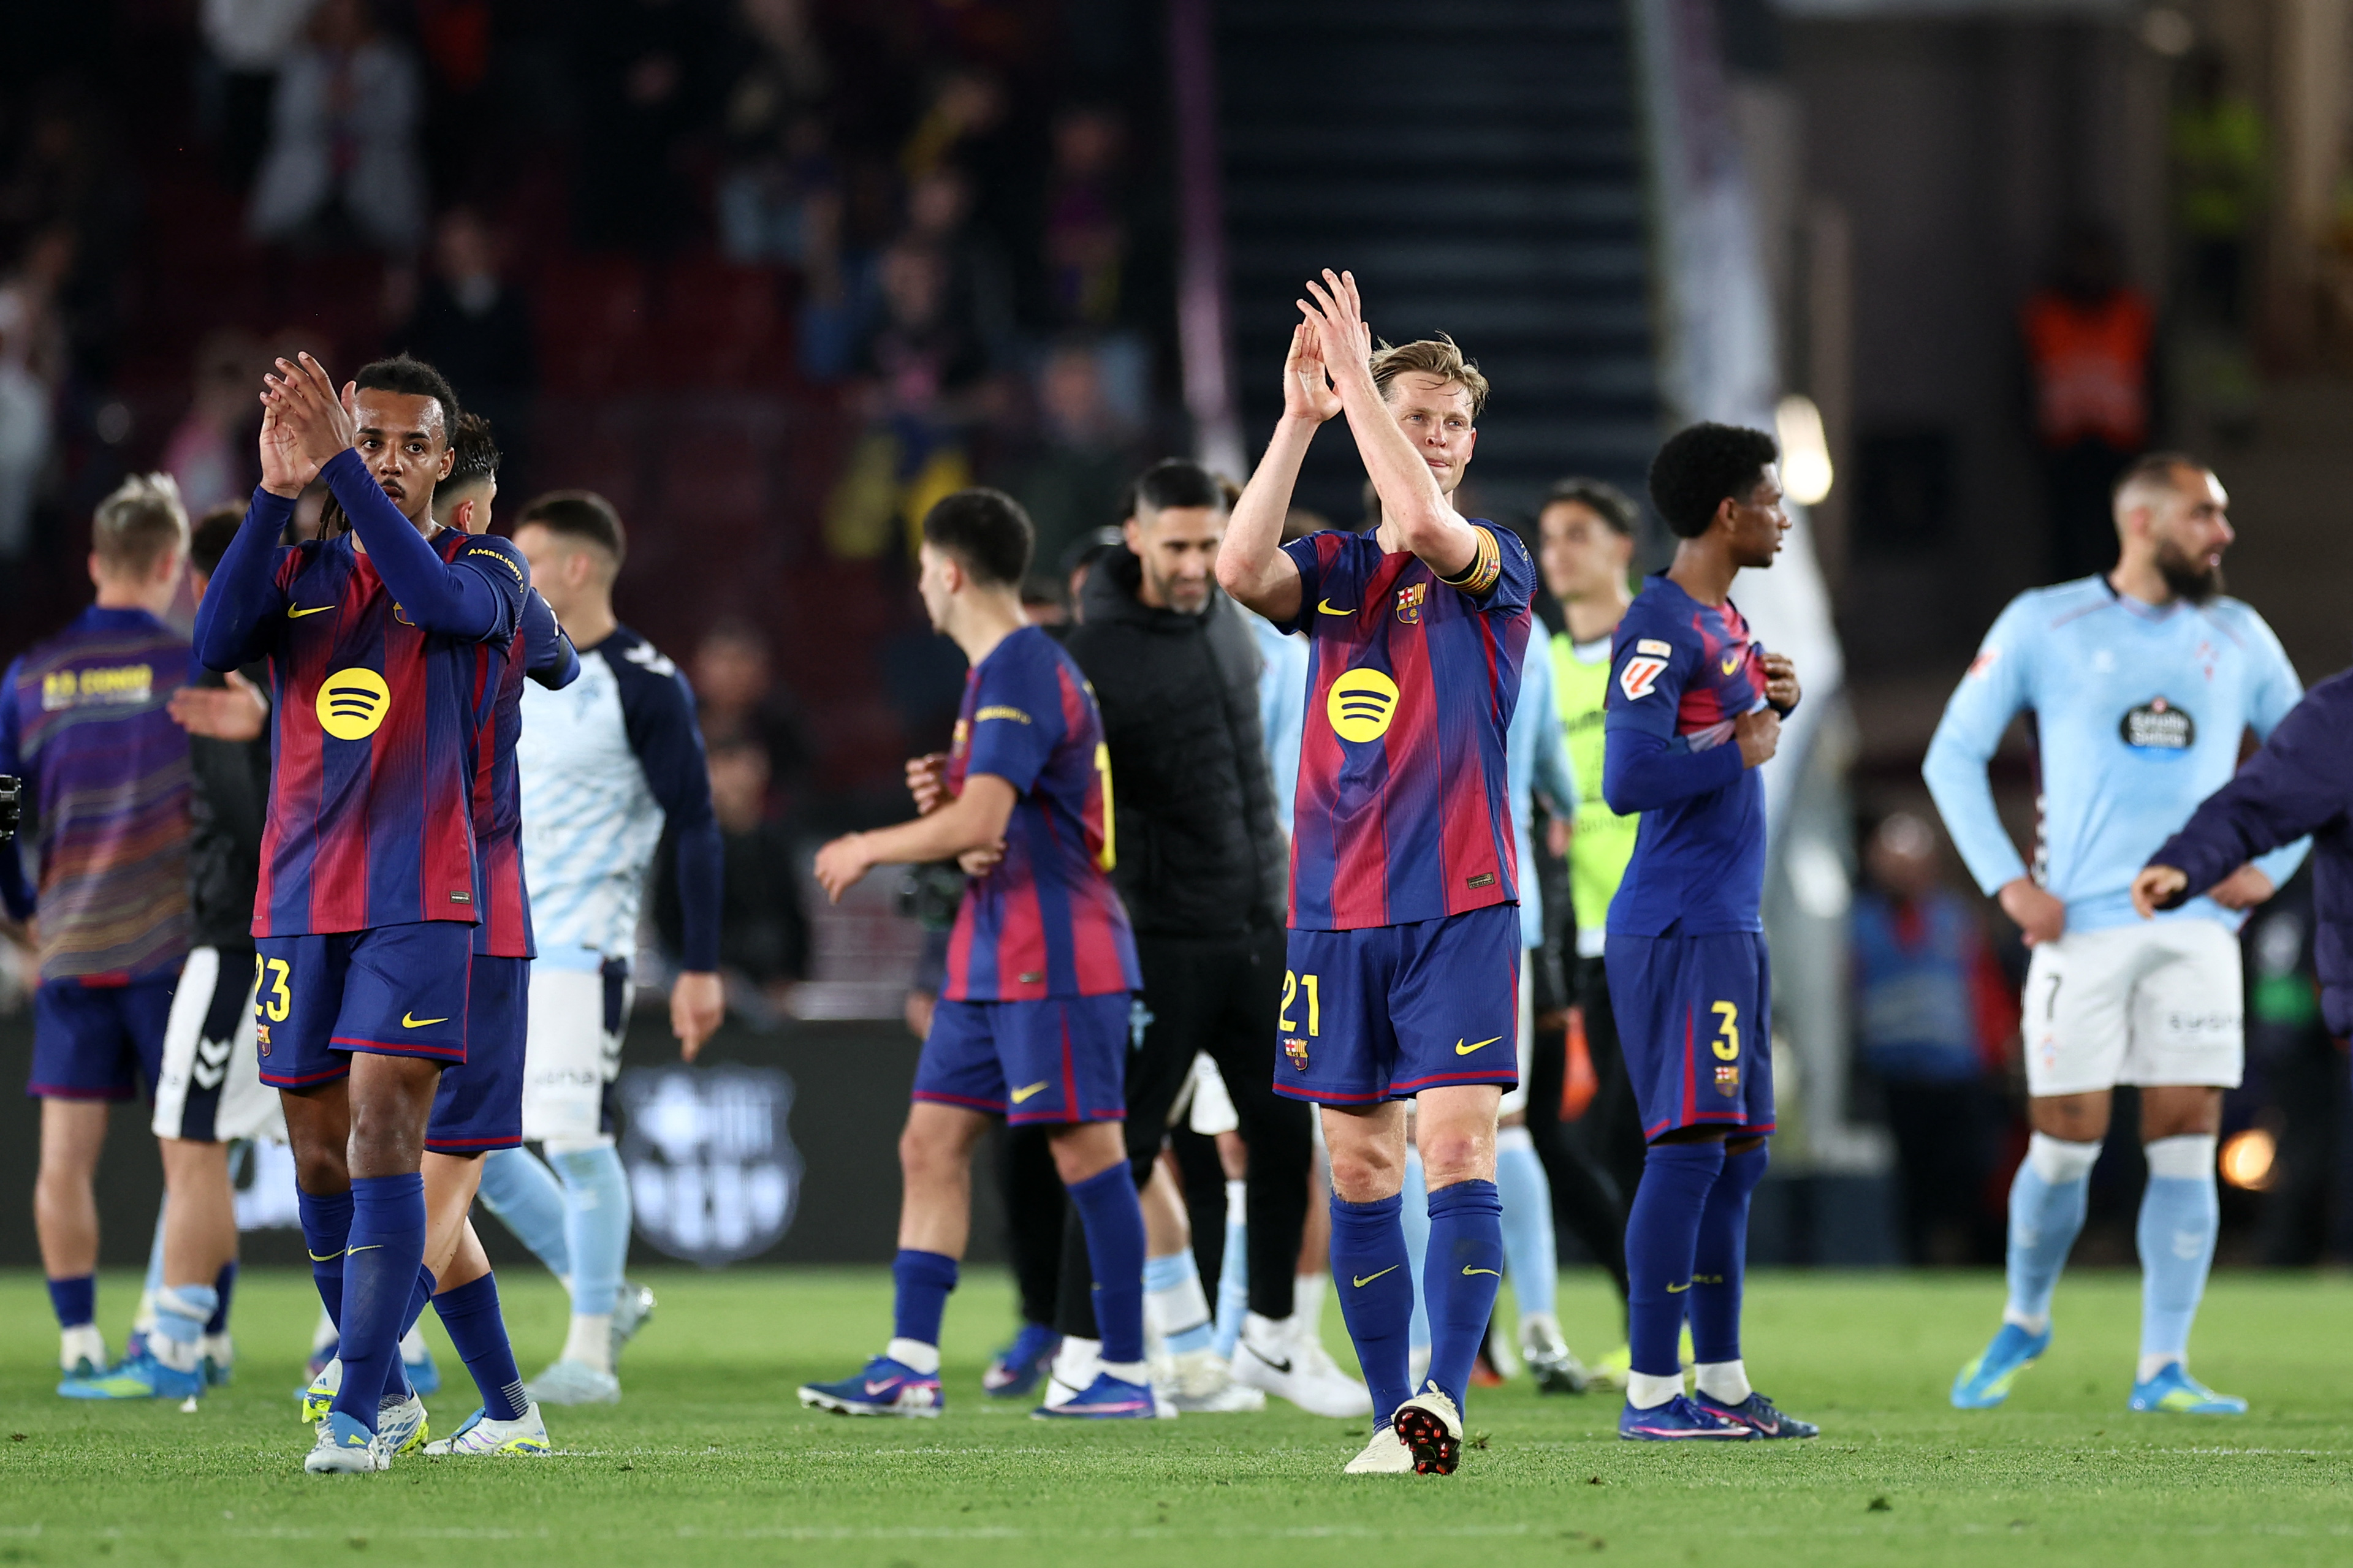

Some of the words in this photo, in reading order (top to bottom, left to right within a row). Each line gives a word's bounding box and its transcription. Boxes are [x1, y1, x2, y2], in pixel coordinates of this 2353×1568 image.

[468, 548, 523, 581] AMBILIGHT
[519, 583, 524, 594] TV
[254, 952, 291, 1022] 23
[1279, 969, 1320, 1037] 21
[2045, 972, 2063, 1022] 7
[1710, 999, 1740, 1061] 3
